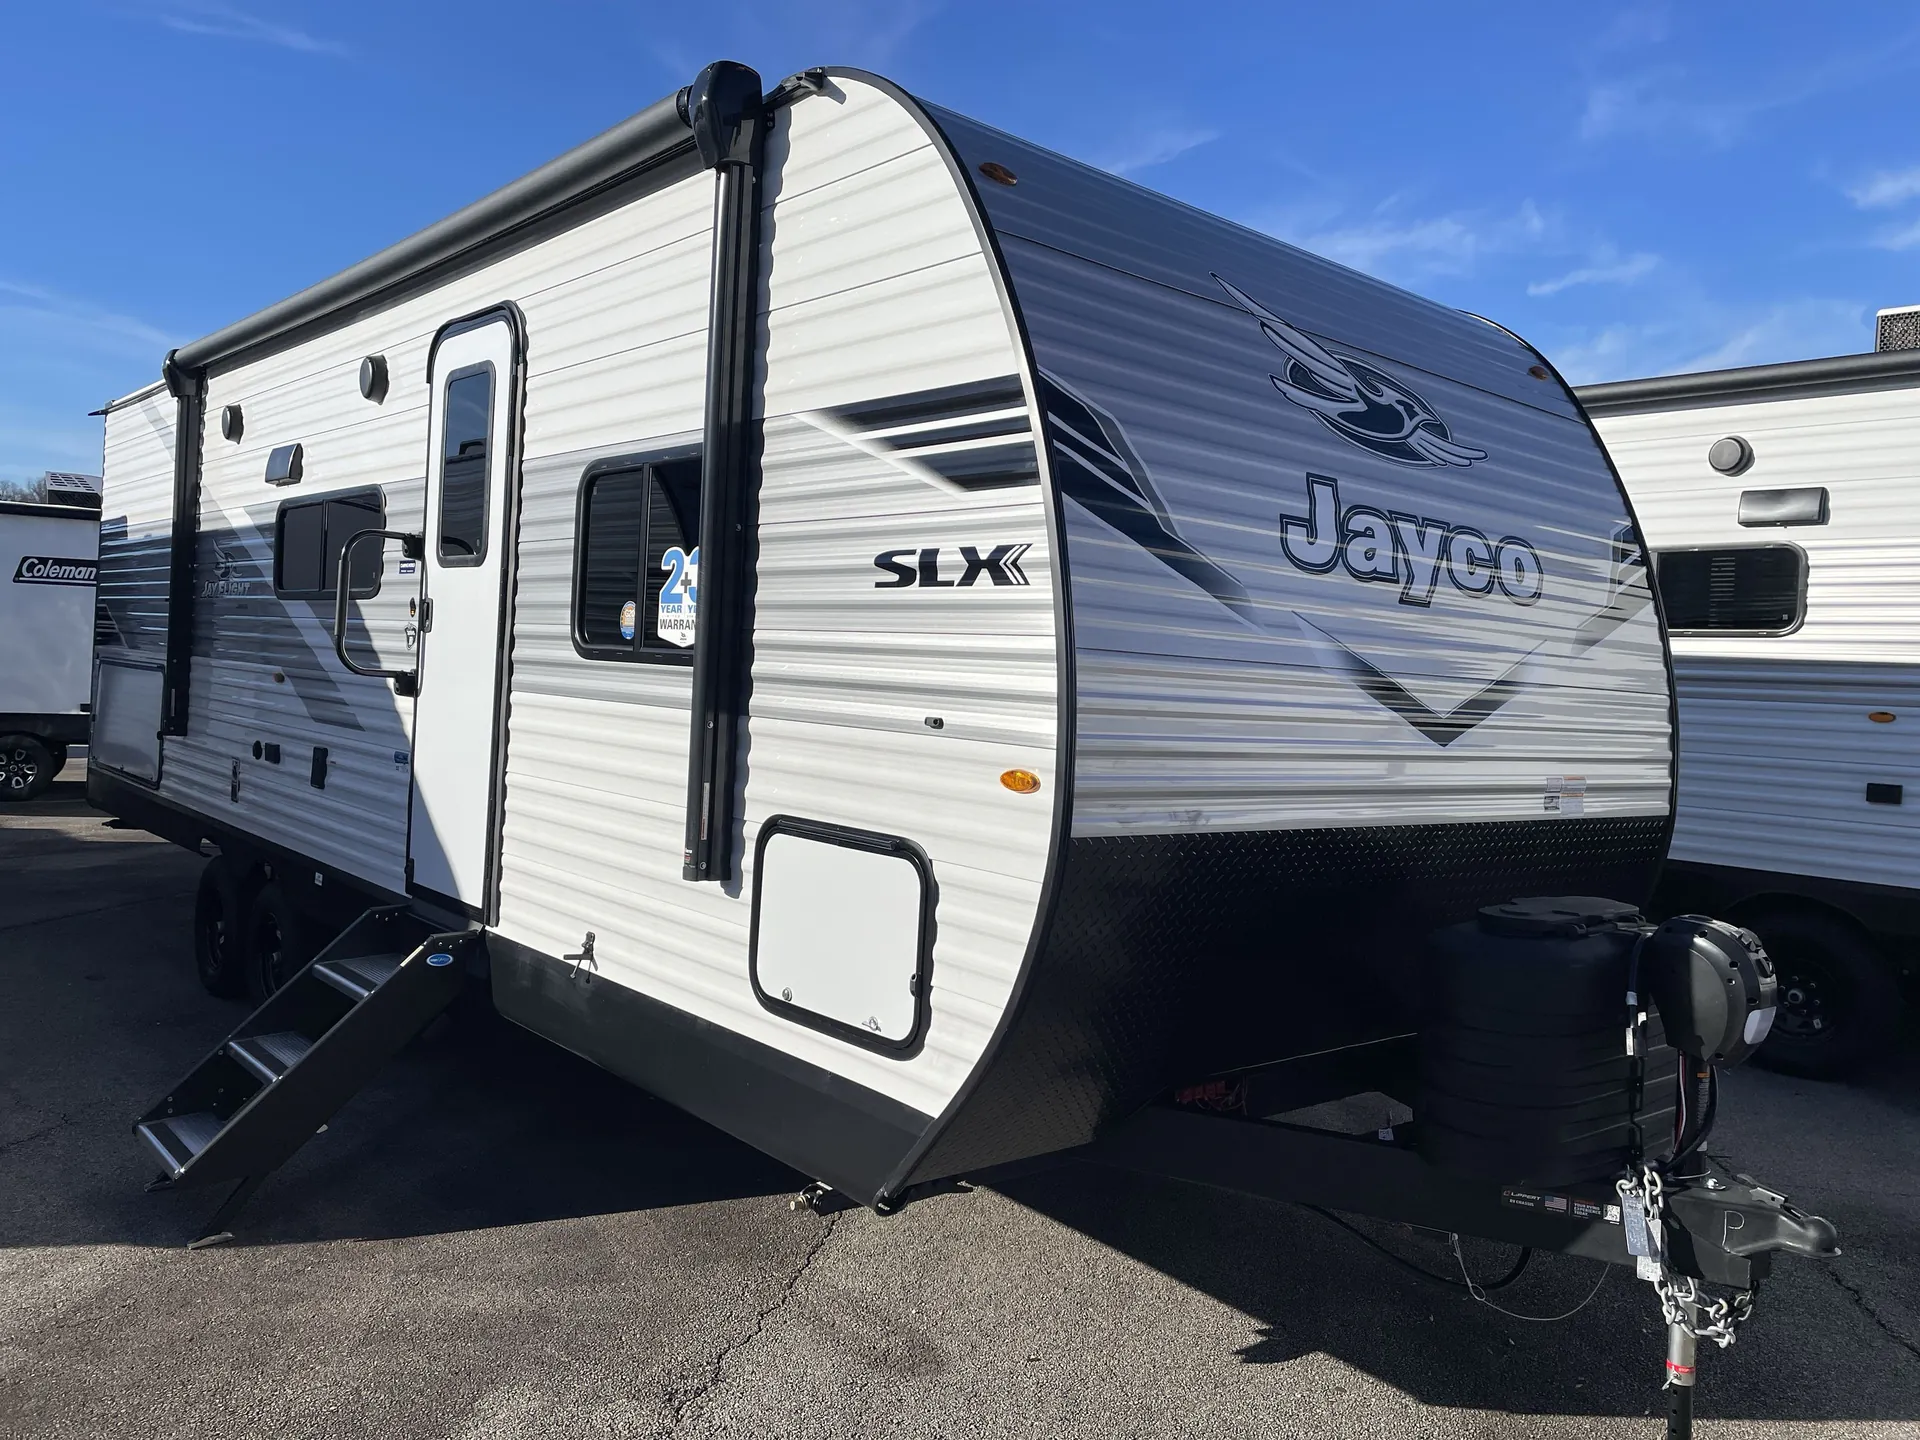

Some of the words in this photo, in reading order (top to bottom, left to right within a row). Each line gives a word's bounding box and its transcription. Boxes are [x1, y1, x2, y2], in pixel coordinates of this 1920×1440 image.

[1279, 472, 1544, 607] Jayco
[22, 558, 97, 579] Coleman
[873, 543, 1033, 588] SLX
[201, 581, 217, 597] JAY
[218, 581, 250, 596] FLIGHT
[661, 604, 682, 613] YEAR
[1721, 1210, 1745, 1246] P
